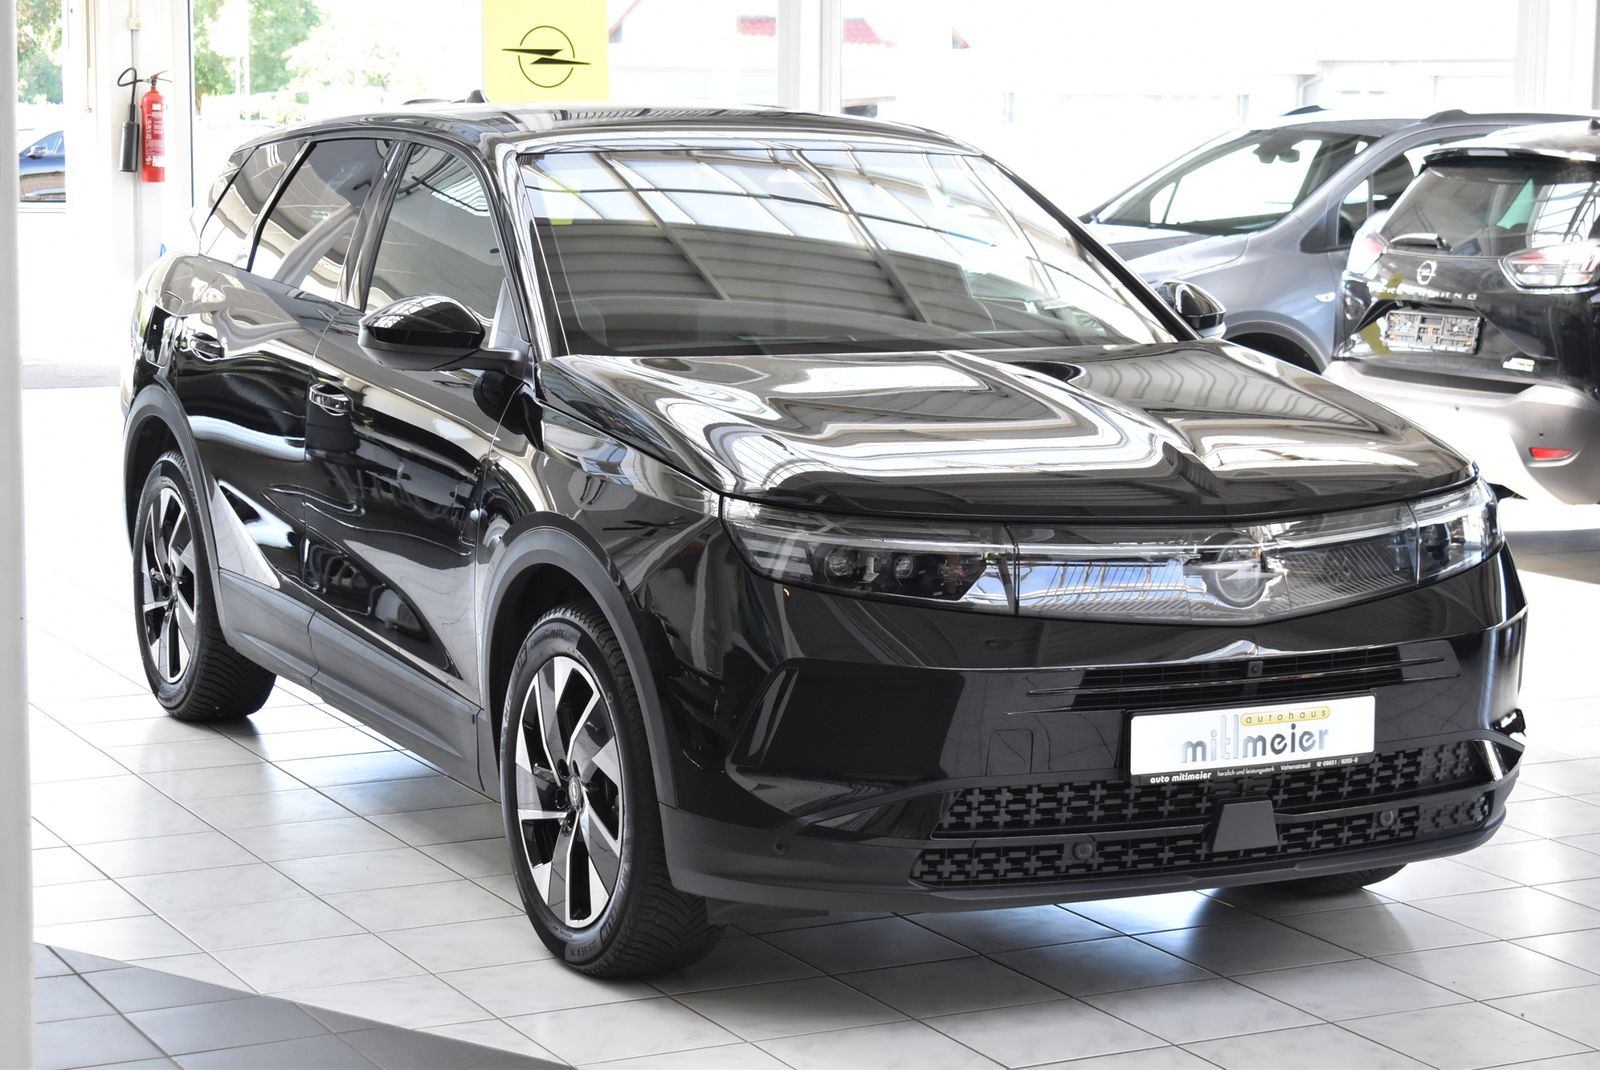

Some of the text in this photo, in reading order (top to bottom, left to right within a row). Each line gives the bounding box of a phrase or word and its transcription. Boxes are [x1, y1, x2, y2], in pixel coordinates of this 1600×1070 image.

[1245, 709, 1327, 724] autohaus
[1181, 714, 1329, 764] mitlmeier
[1150, 776, 1170, 784] auto
[1172, 771, 1212, 782] mitlmeier
